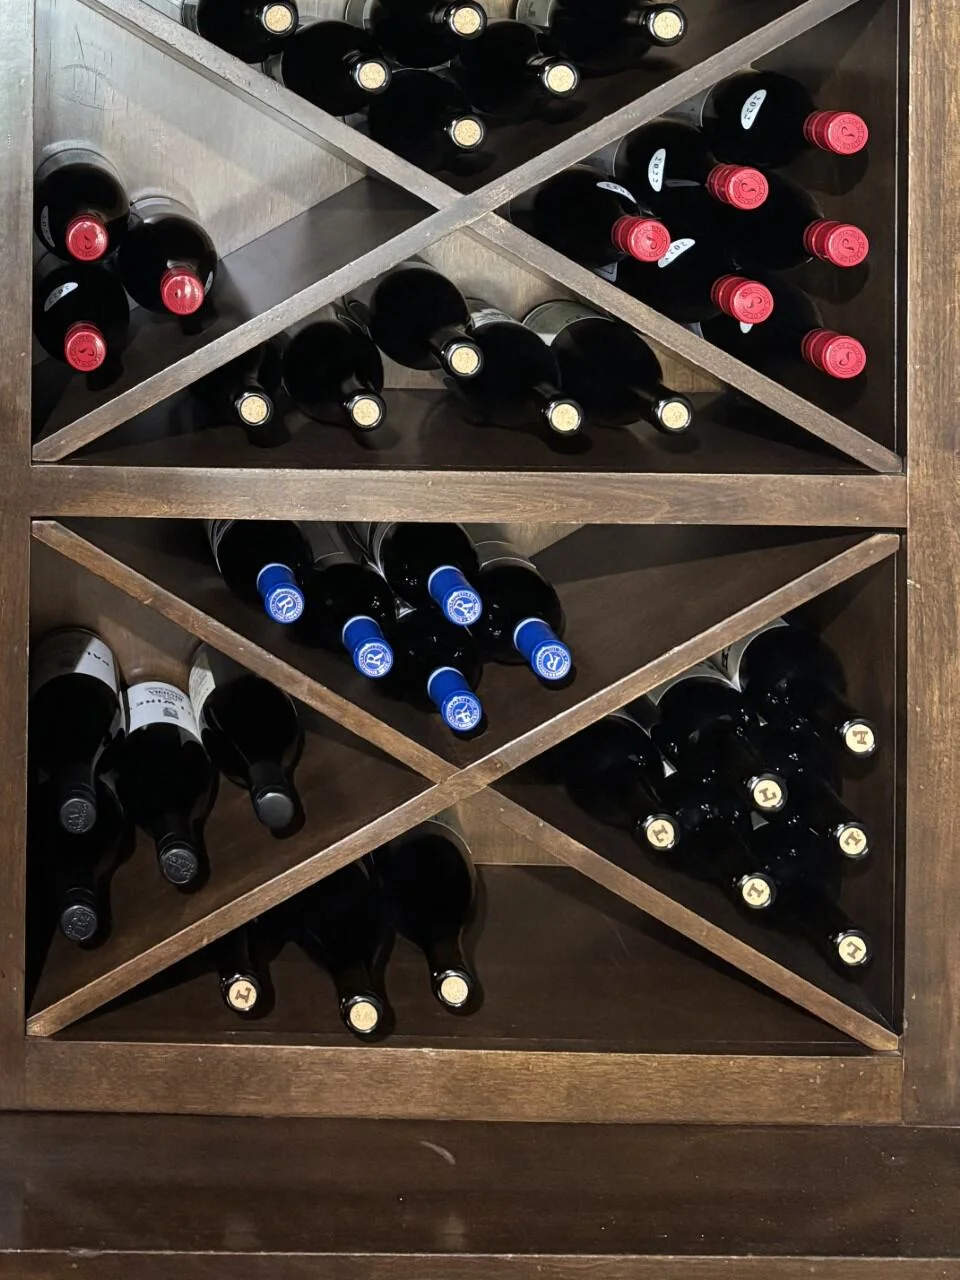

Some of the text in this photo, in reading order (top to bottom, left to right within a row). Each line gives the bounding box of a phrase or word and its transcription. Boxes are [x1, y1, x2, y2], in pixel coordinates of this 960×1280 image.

[278, 596, 294, 615] R
[454, 600, 473, 616] R
[366, 652, 384, 665] R
[546, 653, 561, 672] R
